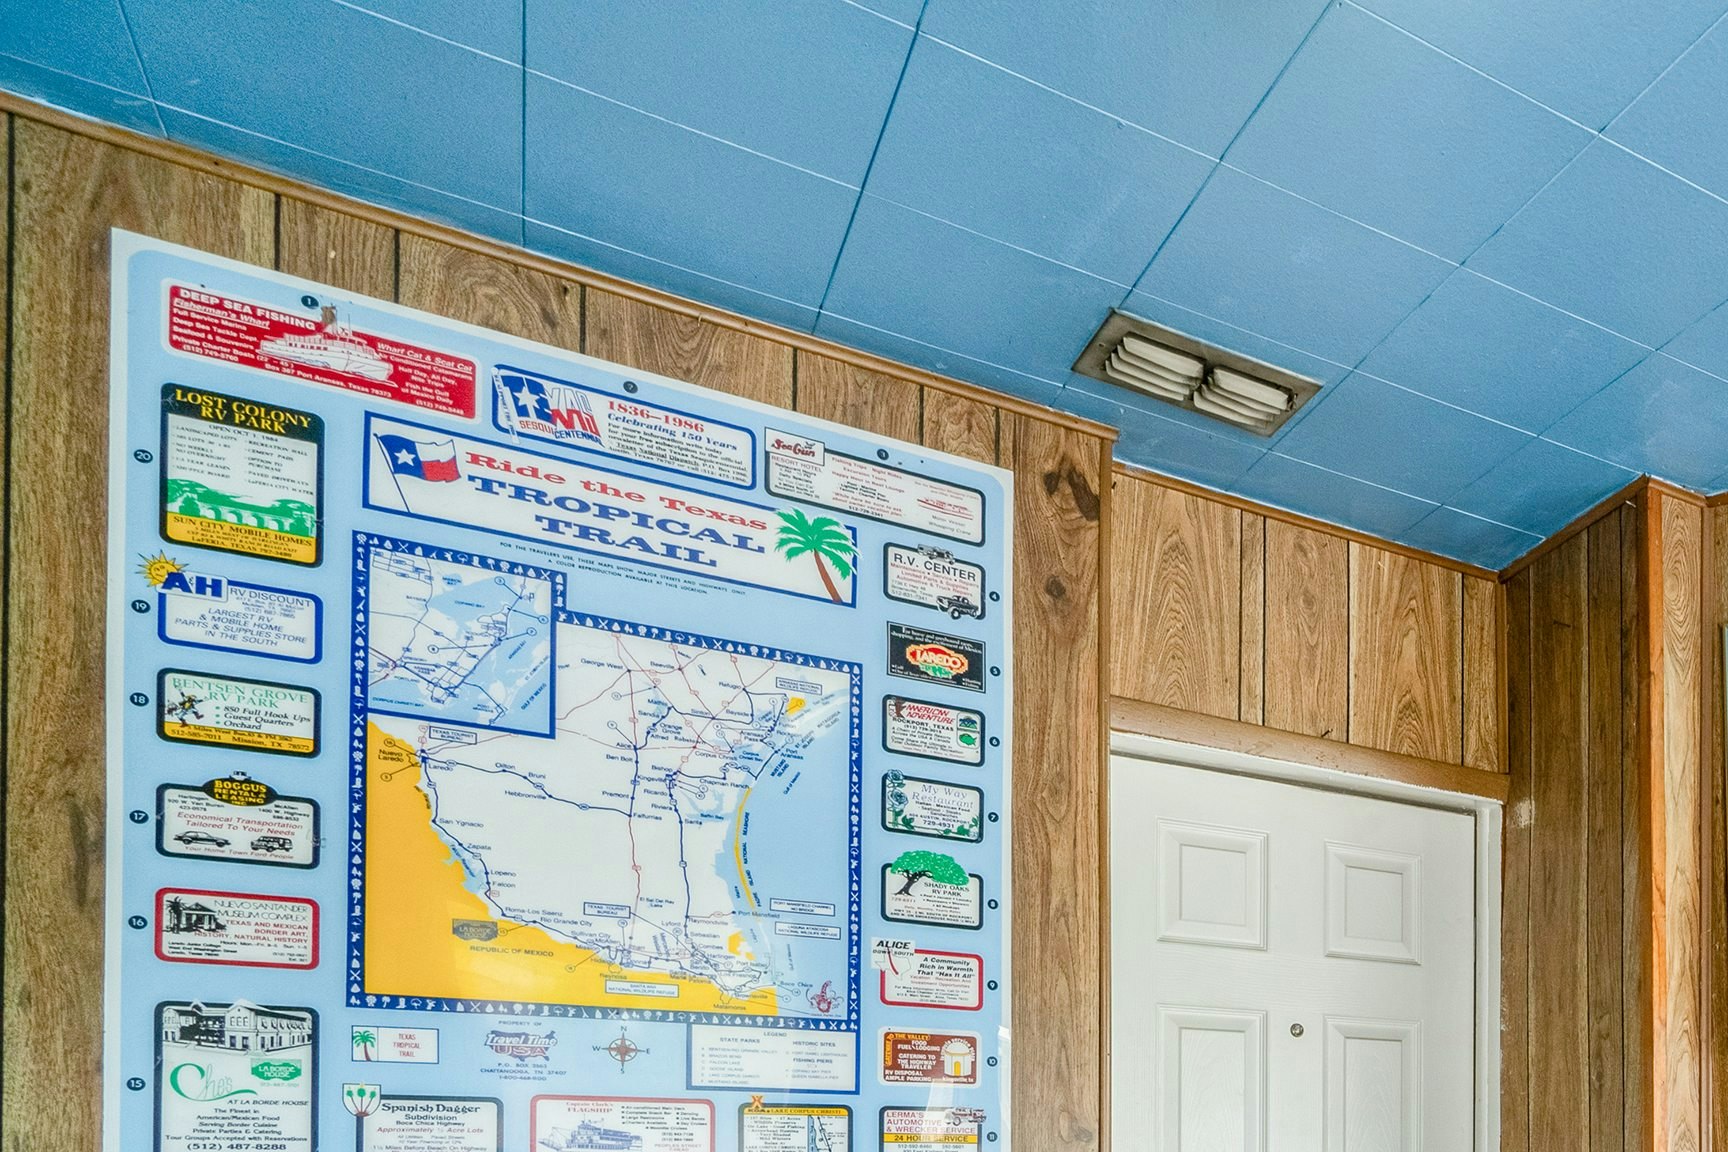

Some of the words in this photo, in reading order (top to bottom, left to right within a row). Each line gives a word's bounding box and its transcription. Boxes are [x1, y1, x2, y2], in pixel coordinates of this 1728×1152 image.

[180, 289, 220, 305] DEEP
[224, 299, 252, 314] SEA
[256, 306, 315, 330] FISHING
[240, 314, 270, 327] Wharf
[378, 343, 404, 354] Wharf
[407, 350, 424, 360] Cat
[457, 362, 473, 371] Cat
[175, 389, 227, 409] LOST
[232, 402, 311, 428] COLONY
[201, 406, 227, 421] RV
[234, 413, 286, 434] PARK
[608, 413, 676, 437] Celebrating
[682, 432, 702, 442] 150
[706, 437, 737, 450] Years
[465, 452, 566, 484] Ride
[580, 480, 646, 502] the
[659, 496, 767, 531] Texas
[468, 475, 766, 553] TROPICAL
[174, 516, 197, 525] SUN
[200, 520, 225, 530] CITY
[229, 525, 272, 539] MOBILE
[274, 534, 312, 547] HOMES
[535, 514, 717, 567] TRAIL
[894, 553, 919, 568] R.V.
[924, 561, 976, 582] CENTER
[135, 602, 146, 610] 19
[230, 588, 246, 597] RV
[250, 591, 311, 608] DISCOUNT
[208, 608, 255, 621] LARGEST
[259, 615, 273, 623] RV
[211, 616, 250, 628] MOBILE
[253, 622, 283, 632] HOME
[916, 651, 962, 668] LAREDO
[133, 695, 145, 703] 18
[173, 678, 245, 695] BENTSEN
[252, 688, 308, 703] GROVE
[209, 691, 233, 703] RV
[237, 696, 279, 709] PARK
[224, 721, 262, 730] Orchard
[215, 780, 267, 793] BOGGUS
[133, 813, 145, 821] 17
[177, 812, 232, 823] Economical
[237, 817, 303, 829] Transportation
[877, 940, 910, 949] ALICE
[130, 1080, 142, 1088] 15
[381, 1103, 434, 1113] Spanish
[436, 1104, 481, 1114] Dagger
